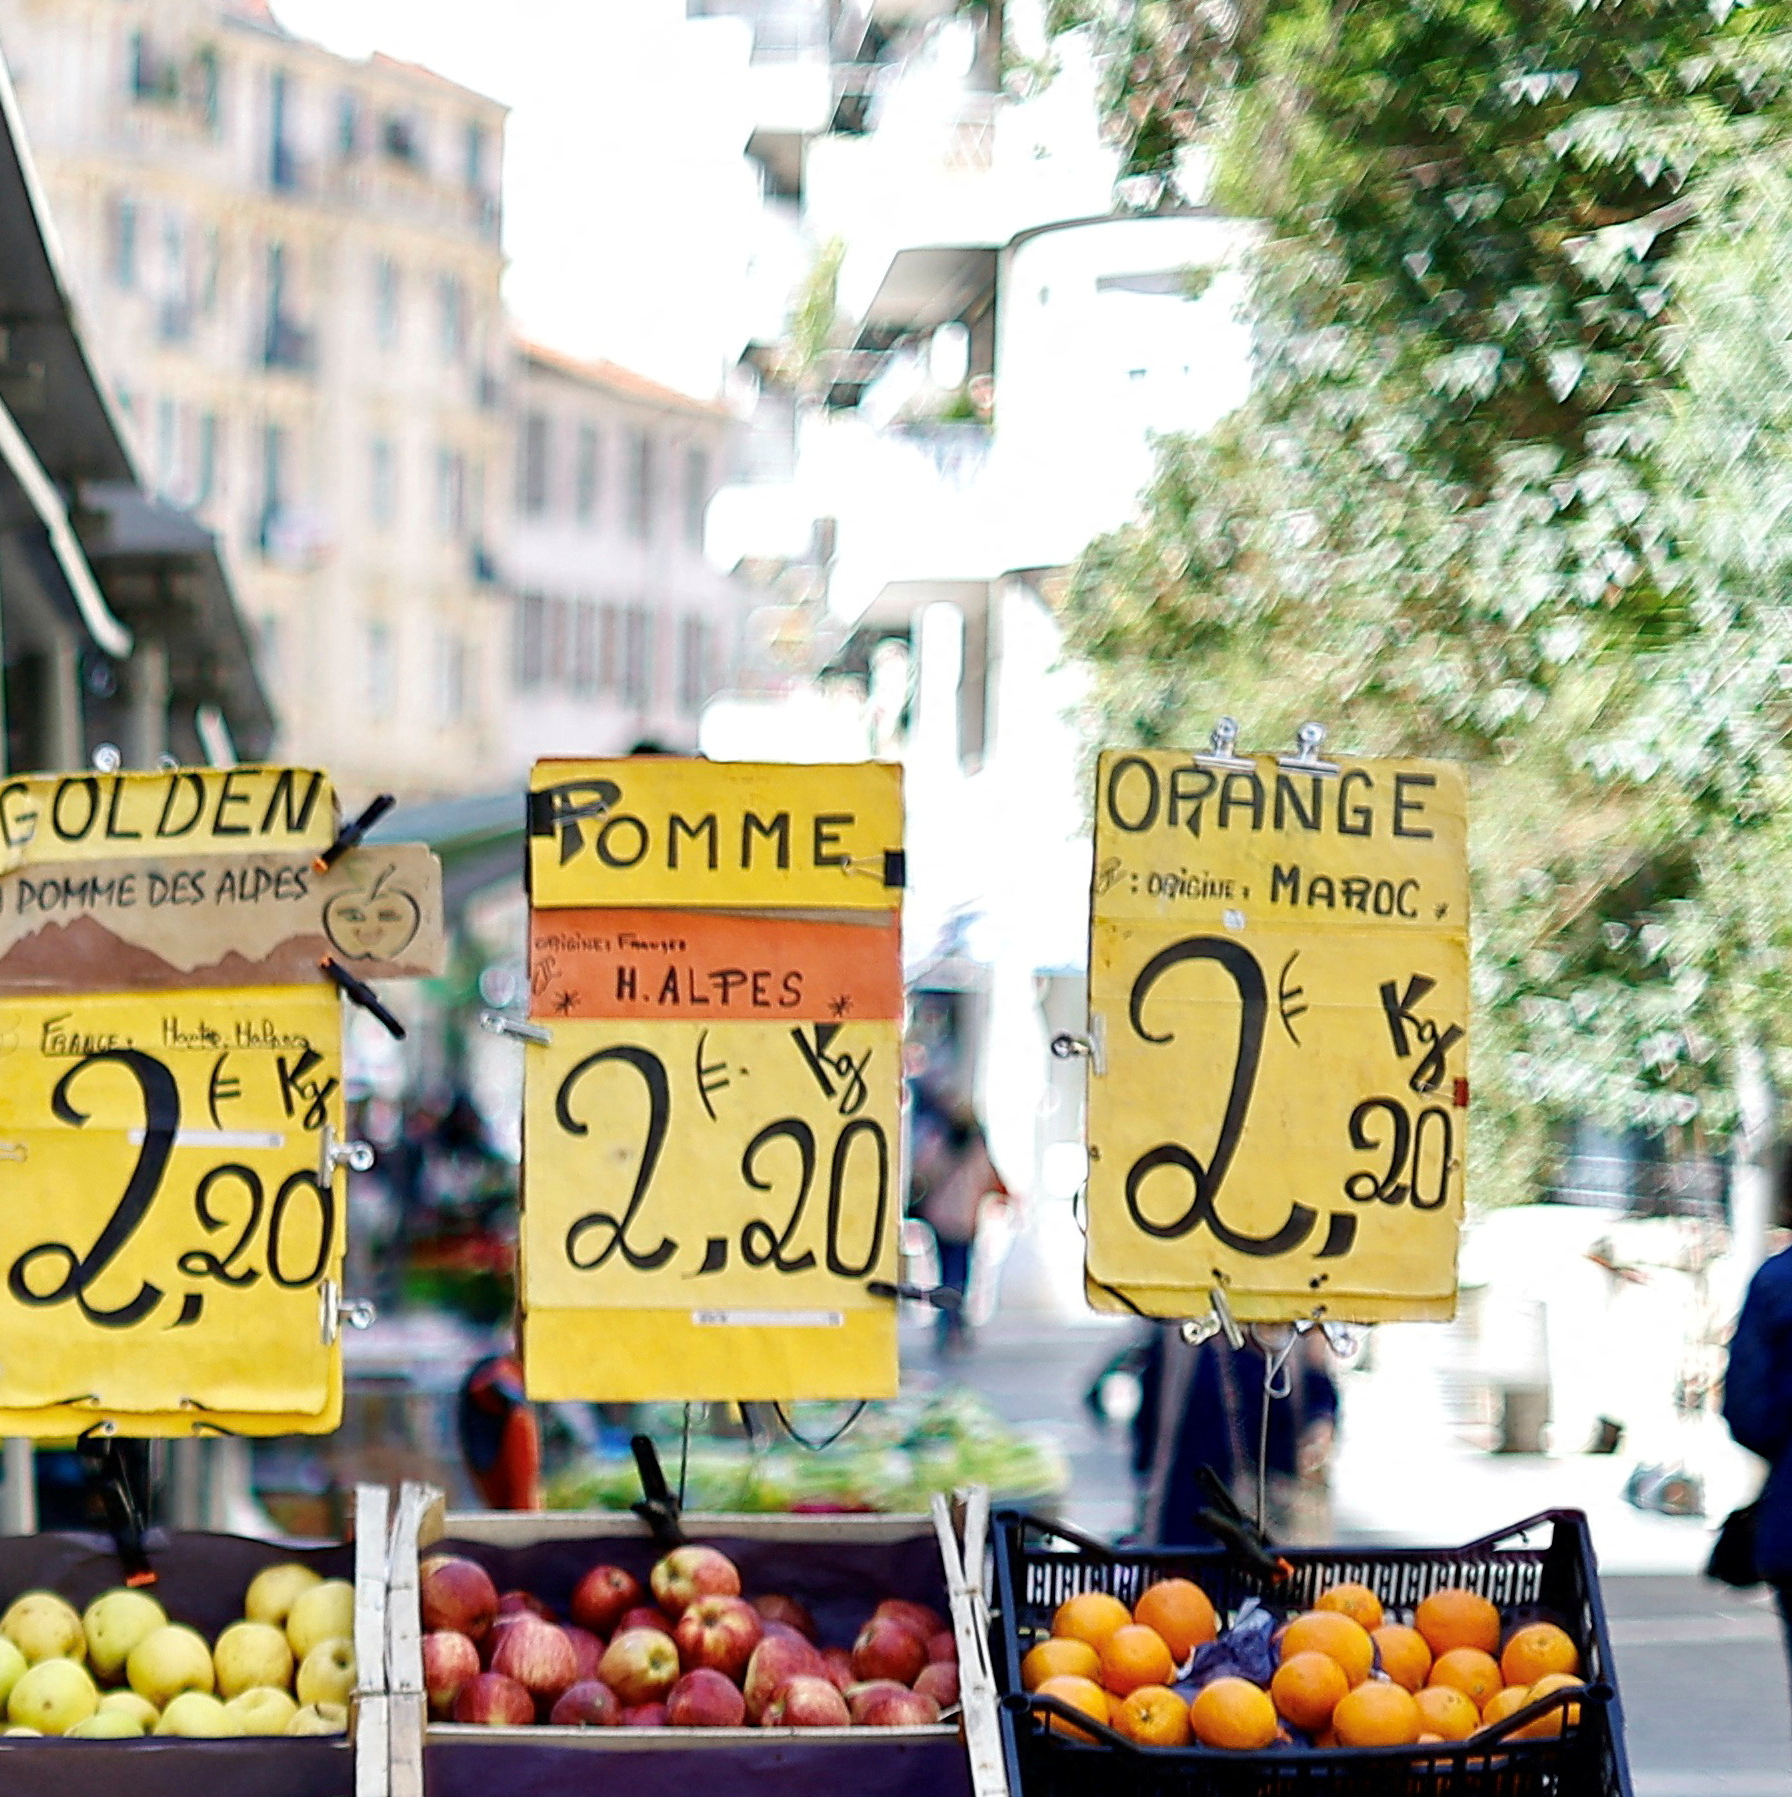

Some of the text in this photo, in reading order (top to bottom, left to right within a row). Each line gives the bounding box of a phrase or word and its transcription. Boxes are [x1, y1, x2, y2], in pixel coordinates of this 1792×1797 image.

[536, 780, 854, 868] POMME
[1108, 757, 1436, 840] ORANGE
[17, 877, 135, 915] POMME
[148, 871, 206, 908] DES
[217, 866, 310, 904] ALPES
[1270, 862, 1420, 918] MAROC
[790, 1023, 873, 1115] Kg
[1380, 973, 1466, 1091] Kg
[276, 1043, 338, 1130] Kg
[555, 1044, 888, 1279] 2,20
